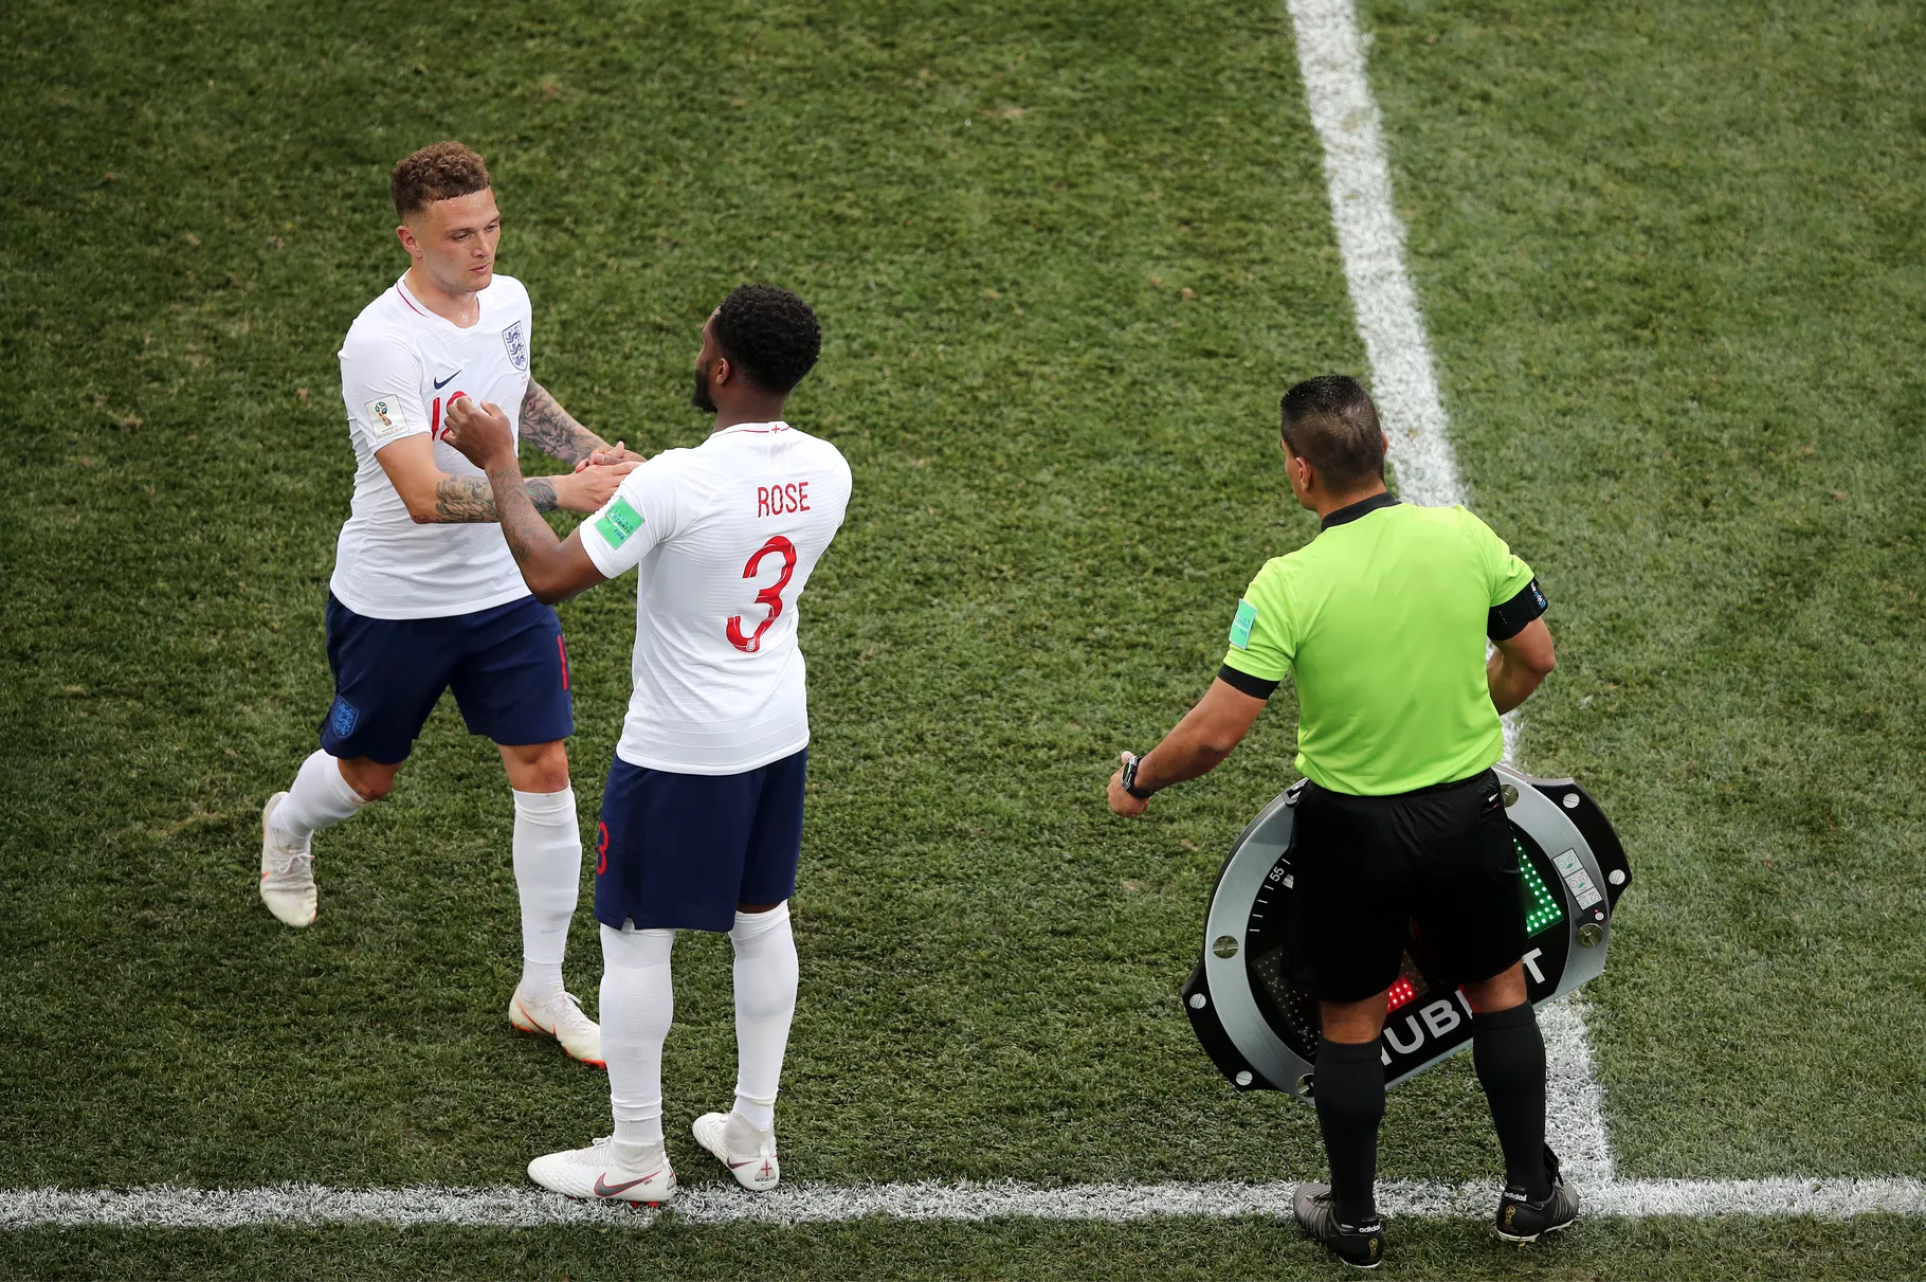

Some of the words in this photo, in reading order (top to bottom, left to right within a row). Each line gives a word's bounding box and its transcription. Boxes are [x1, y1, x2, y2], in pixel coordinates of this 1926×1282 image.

[431, 390, 470, 442] 1
[757, 481, 811, 518] ROSE
[613, 528, 625, 541] FIFA
[725, 535, 798, 653] 3
[1269, 866, 1285, 882] 55
[1380, 947, 1546, 1067] UBT
